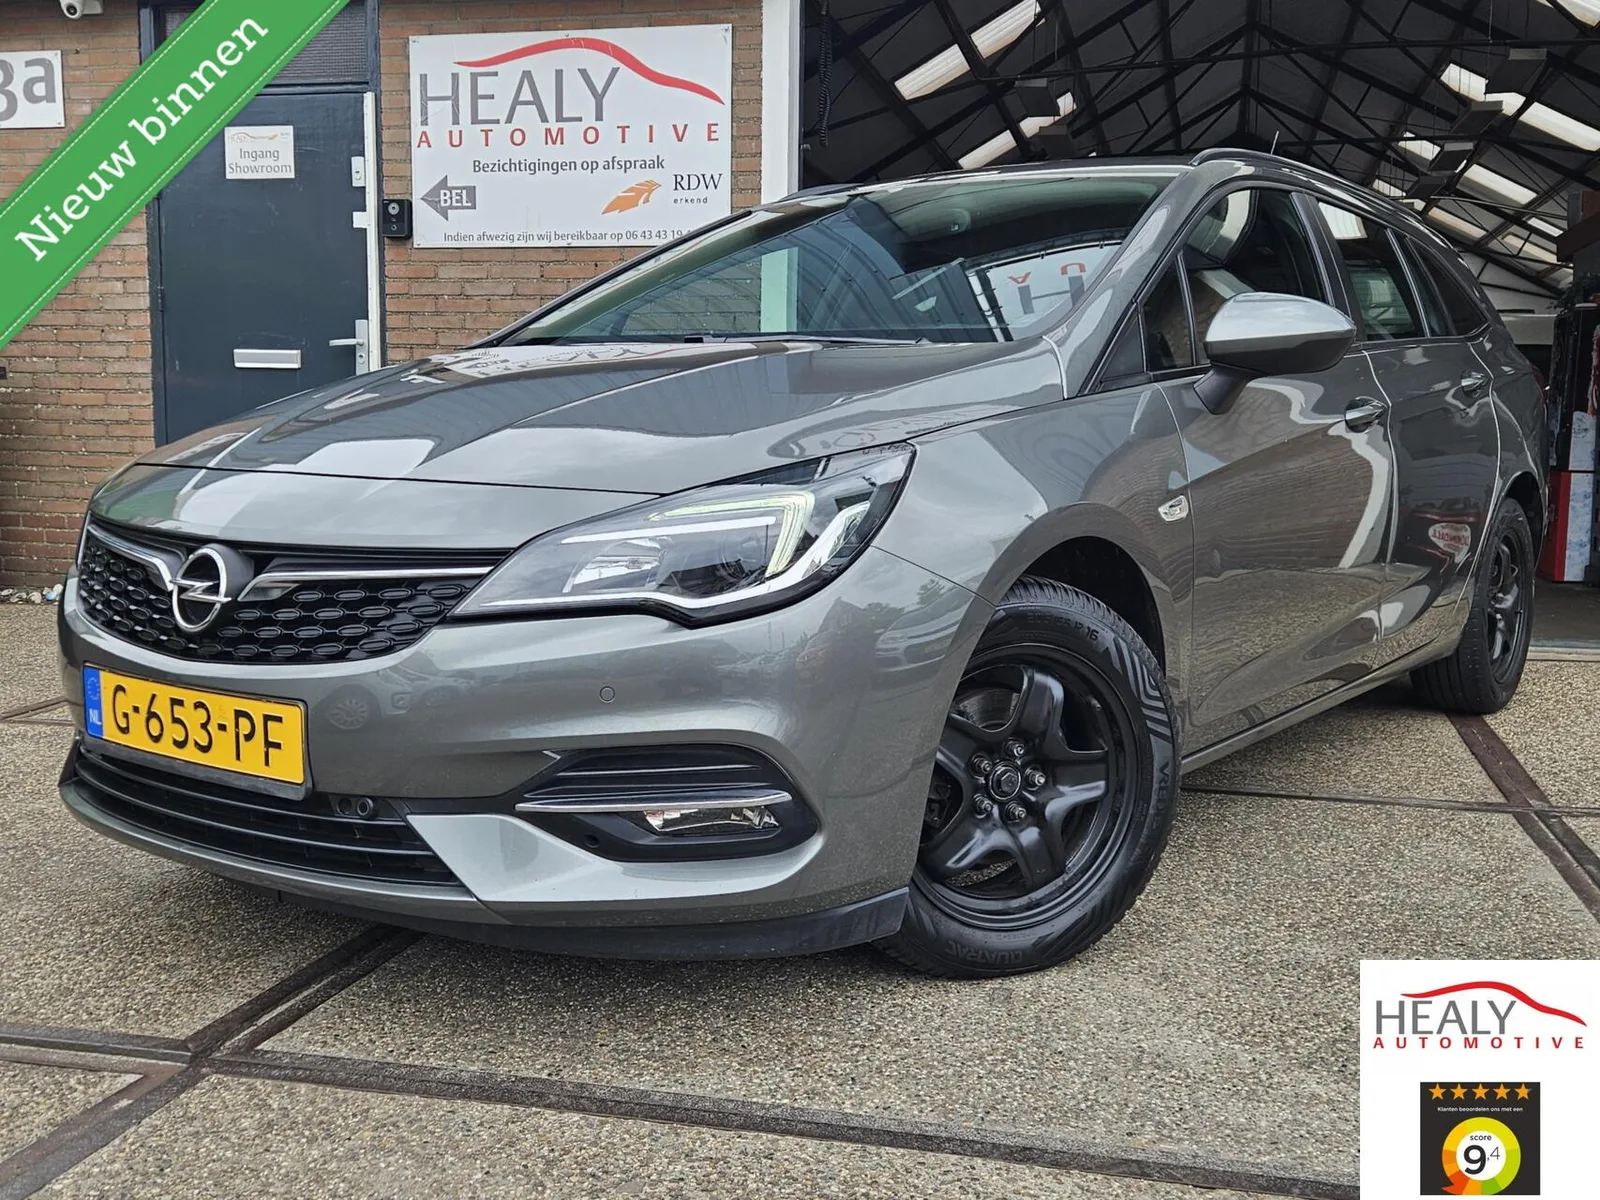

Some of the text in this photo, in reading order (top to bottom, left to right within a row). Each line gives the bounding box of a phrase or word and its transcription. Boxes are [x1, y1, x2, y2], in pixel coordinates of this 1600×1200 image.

[419, 66, 620, 127] HEALY
[416, 122, 720, 149] AUTOMOTIVE
[240, 148, 279, 162] Ingang
[228, 162, 292, 175] Showroom
[472, 155, 665, 176] Bezichtigingen op afspraak
[672, 173, 723, 192] RDW
[439, 188, 472, 208] BEL
[673, 196, 708, 204] erkend
[443, 231, 474, 242] Indien
[476, 231, 515, 244] afwezig
[516, 231, 535, 243] zijn
[536, 231, 552, 243] wij
[554, 230, 608, 242] bereikbaar
[610, 232, 623, 243] op
[625, 229, 639, 240] 06
[640, 229, 653, 240] 43
[655, 229, 668, 240] 43
[671, 229, 683, 240] 19
[1086, 626, 1100, 642] 16
[88, 707, 103, 726] NL
[111, 683, 284, 768] G-653-PF
